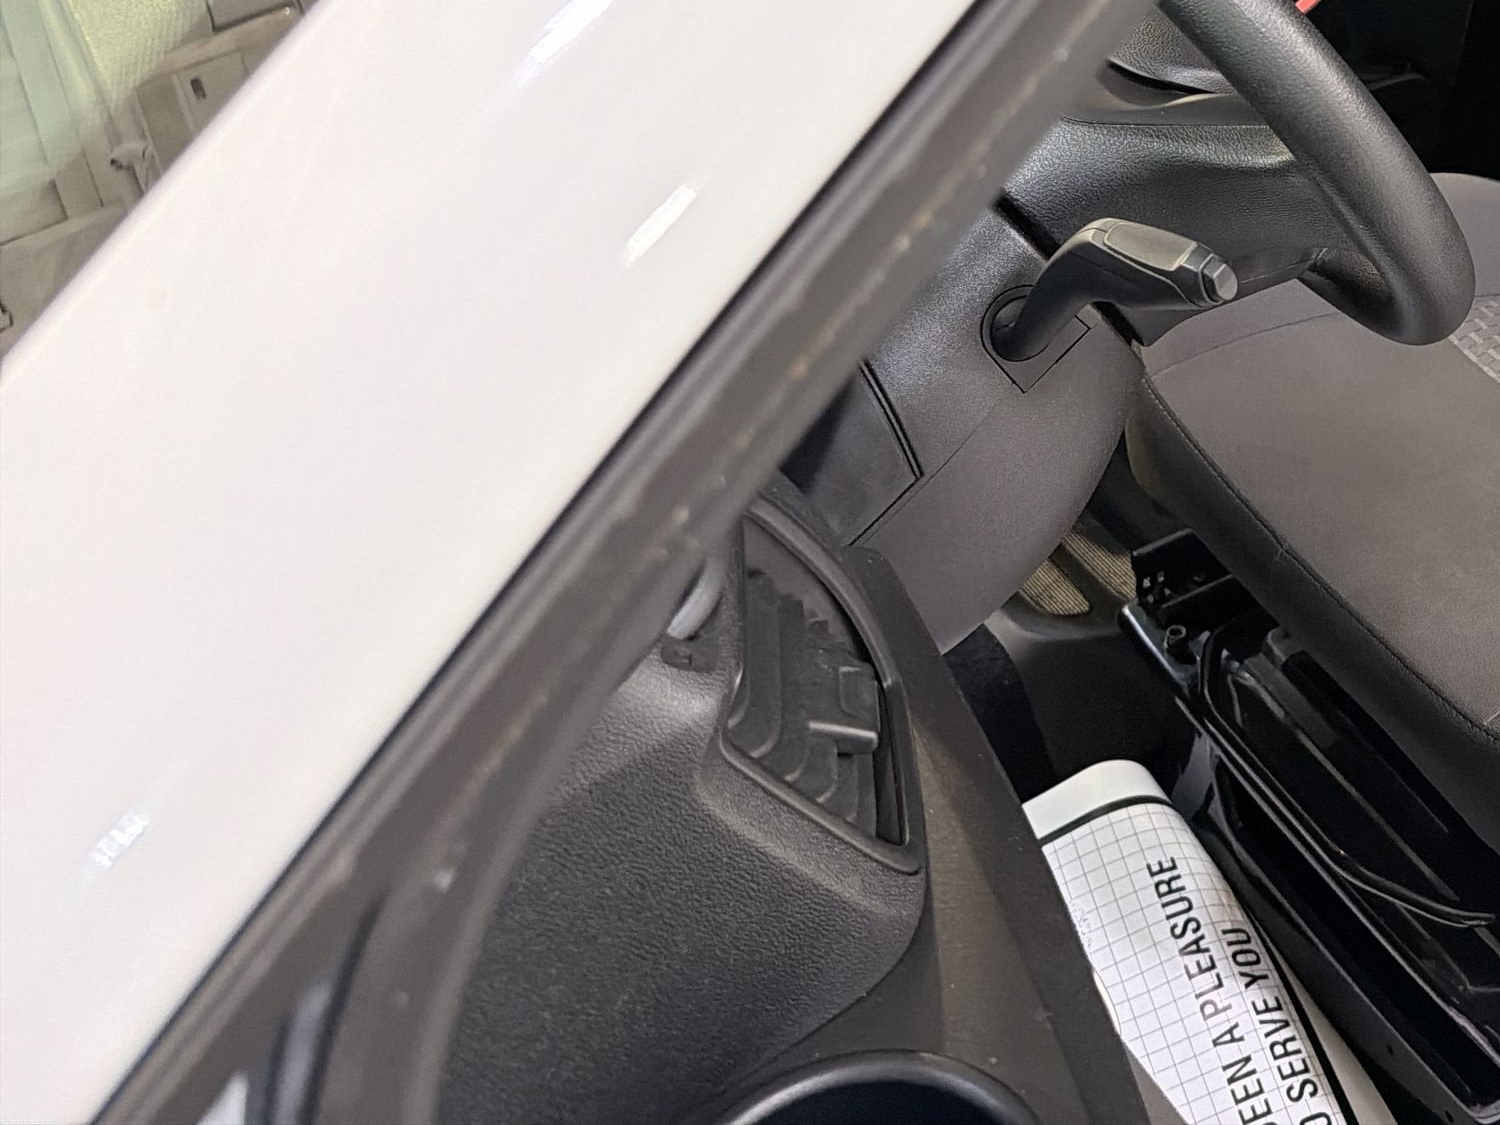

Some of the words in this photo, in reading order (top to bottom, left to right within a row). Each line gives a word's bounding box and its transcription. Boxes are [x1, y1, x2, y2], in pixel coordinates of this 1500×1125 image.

[1146, 856, 1232, 1022] PLEASURE
[1221, 927, 1269, 989] YOU
[1212, 1022, 1245, 1048] A
[1252, 996, 1318, 1103] SERVE
[1221, 1054, 1277, 1125] EEN
